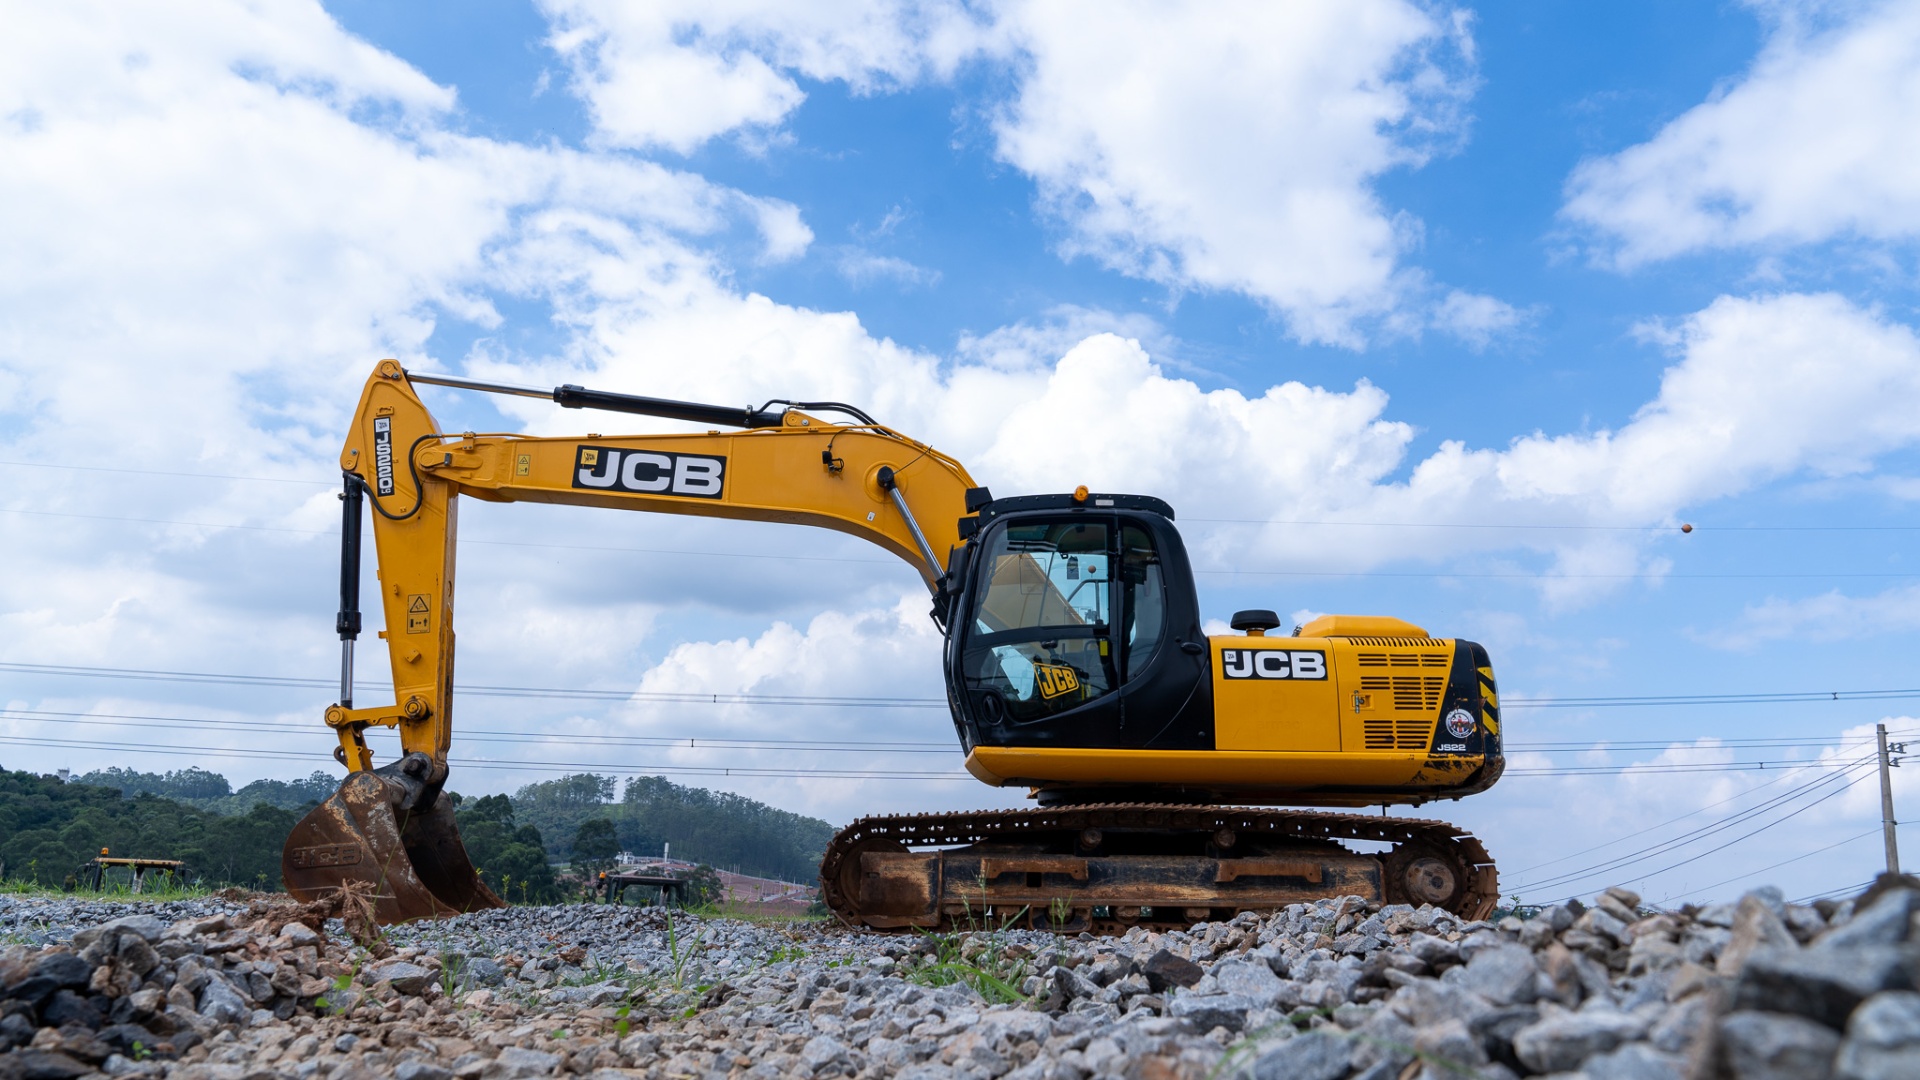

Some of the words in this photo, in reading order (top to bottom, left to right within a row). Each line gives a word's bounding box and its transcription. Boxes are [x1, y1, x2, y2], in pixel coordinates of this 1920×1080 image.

[377, 432, 392, 488] JS220
[579, 451, 722, 495] JCB
[1041, 667, 1076, 695] JCB
[1225, 651, 1326, 678] JCB
